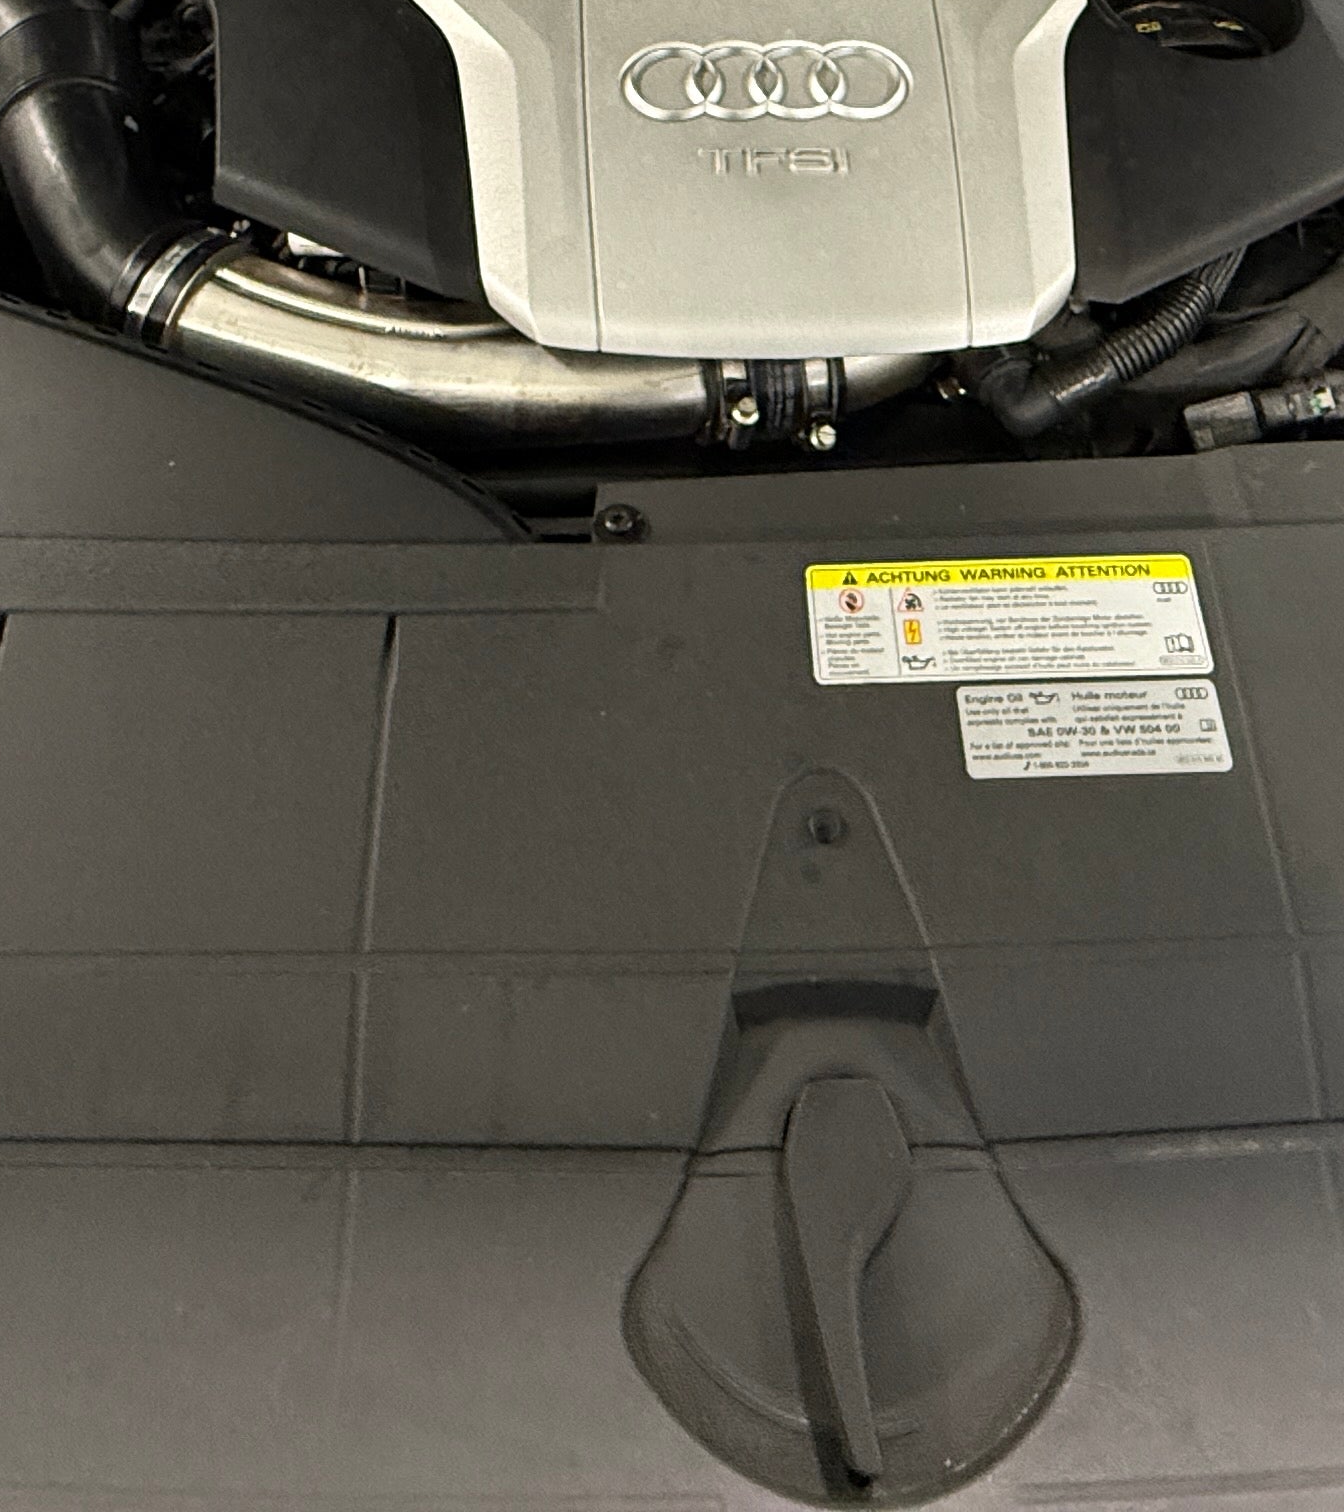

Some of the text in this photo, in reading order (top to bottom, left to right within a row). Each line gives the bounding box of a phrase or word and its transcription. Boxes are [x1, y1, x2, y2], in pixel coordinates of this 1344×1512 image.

[698, 148, 850, 175] TFSI
[866, 563, 1151, 584] ACHTUNG WARNING ATTENTION
[964, 693, 1023, 705] Engine Oil
[1071, 690, 1147, 700] Huile moteur
[1027, 727, 1053, 737] SAE
[1056, 726, 1096, 736] 0W-30
[1113, 724, 1136, 735] VW
[1139, 724, 1162, 734] 504
